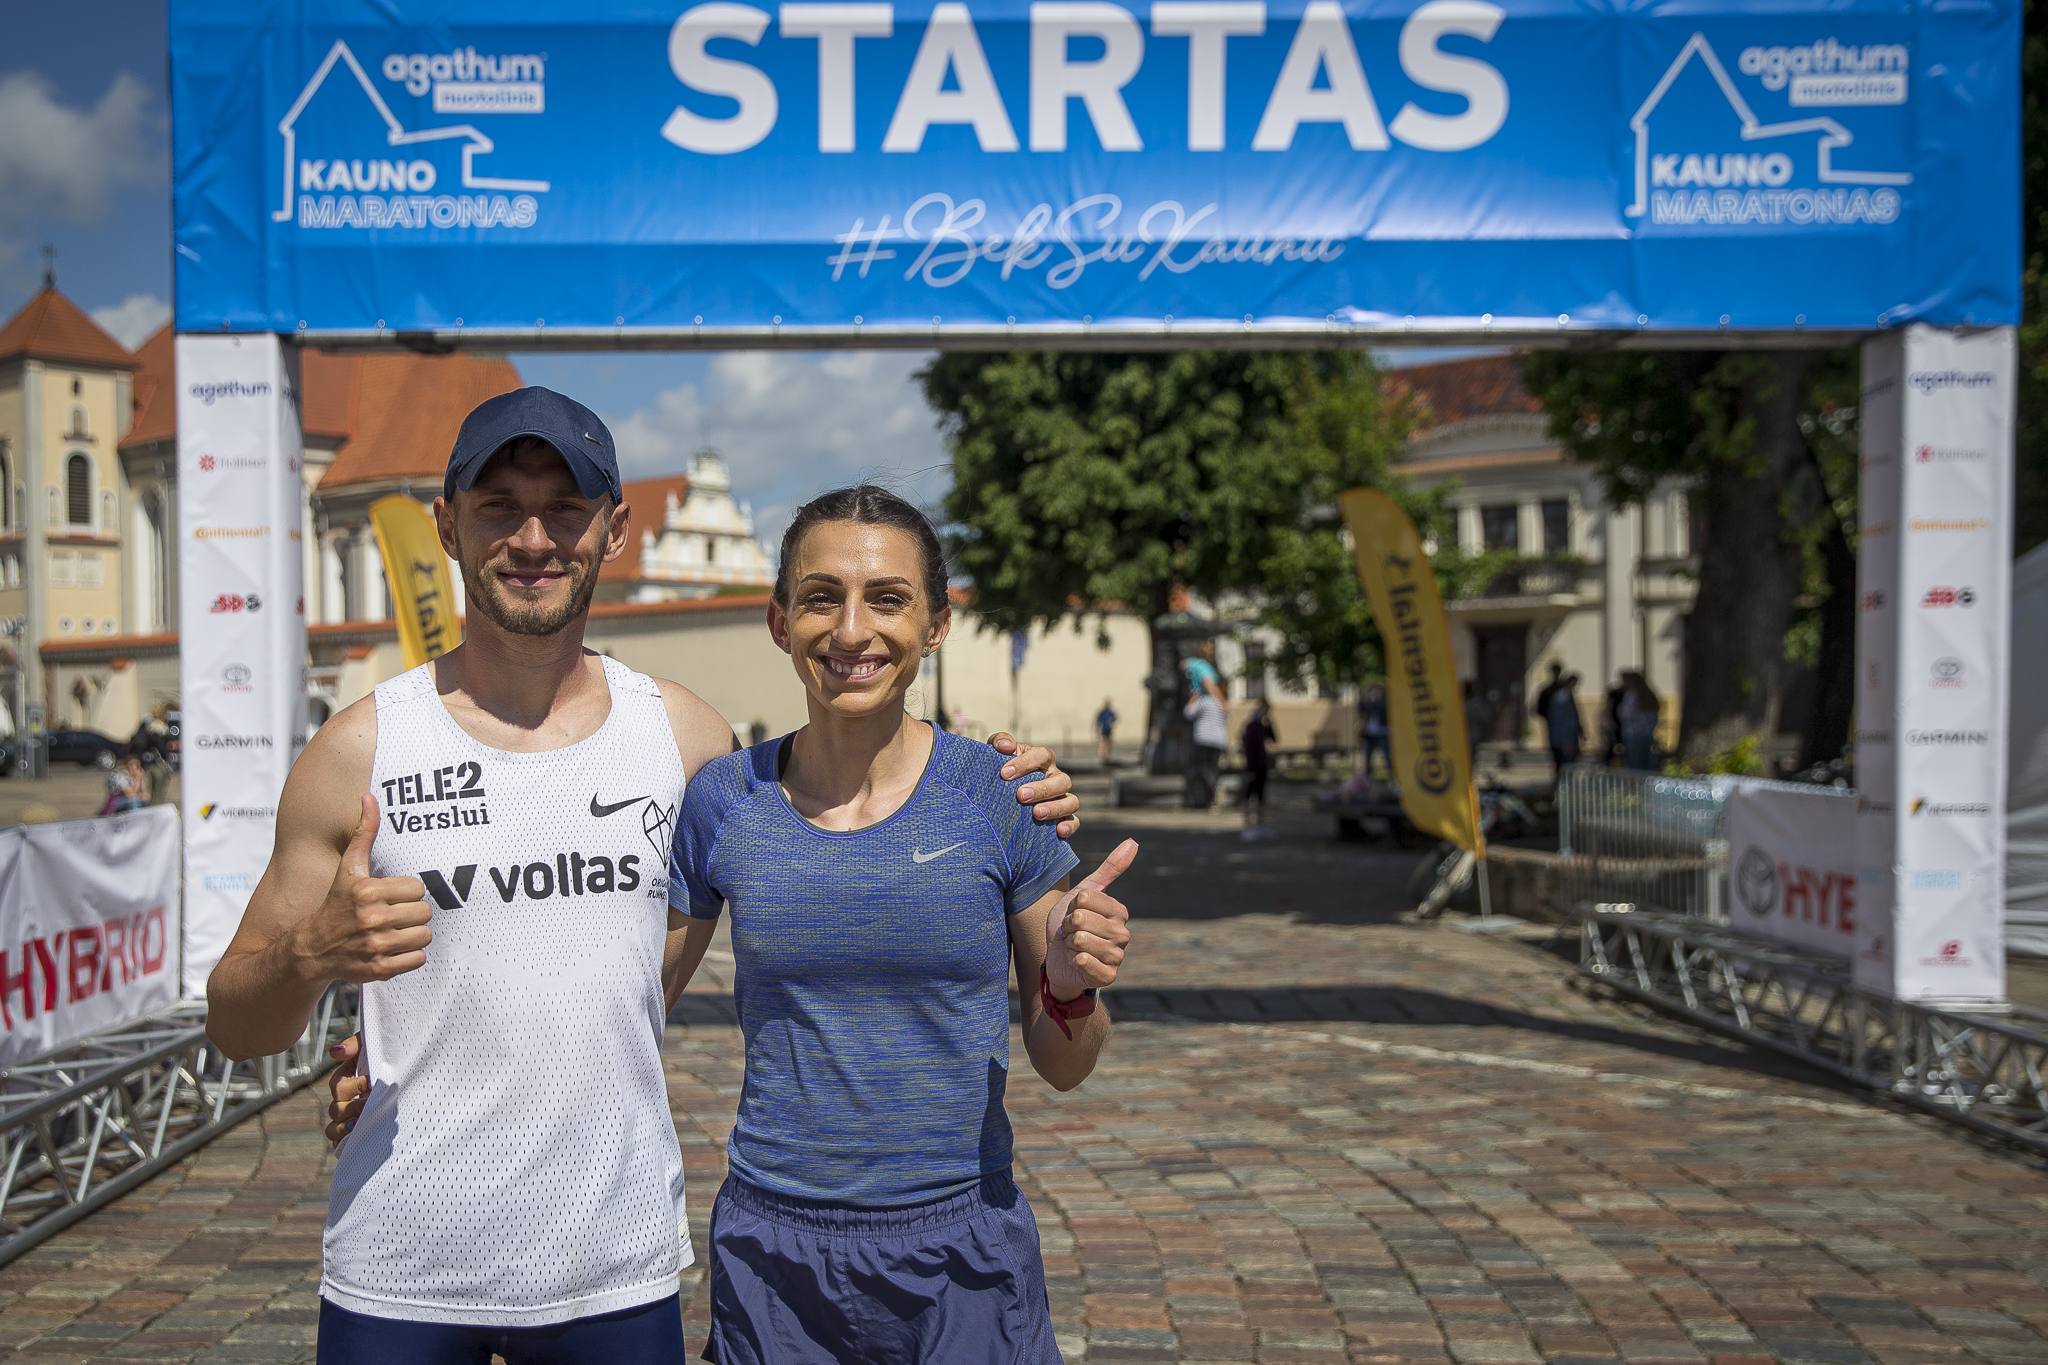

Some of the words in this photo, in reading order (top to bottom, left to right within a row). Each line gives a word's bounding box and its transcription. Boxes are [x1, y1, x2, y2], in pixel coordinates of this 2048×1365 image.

[382, 46, 545, 97] agathum
[660, 0, 1511, 154] STARTAS
[300, 159, 437, 192] KAUNO
[1651, 152, 1795, 187] KAUNO
[298, 195, 538, 229] MARATONAS
[1650, 187, 1901, 225] MARATONAS
[195, 734, 275, 751] GARMIN
[381, 761, 486, 807] TELE2
[387, 803, 491, 835] Verslui
[489, 852, 641, 903] voltas
[0, 904, 167, 1032] HYBRID
